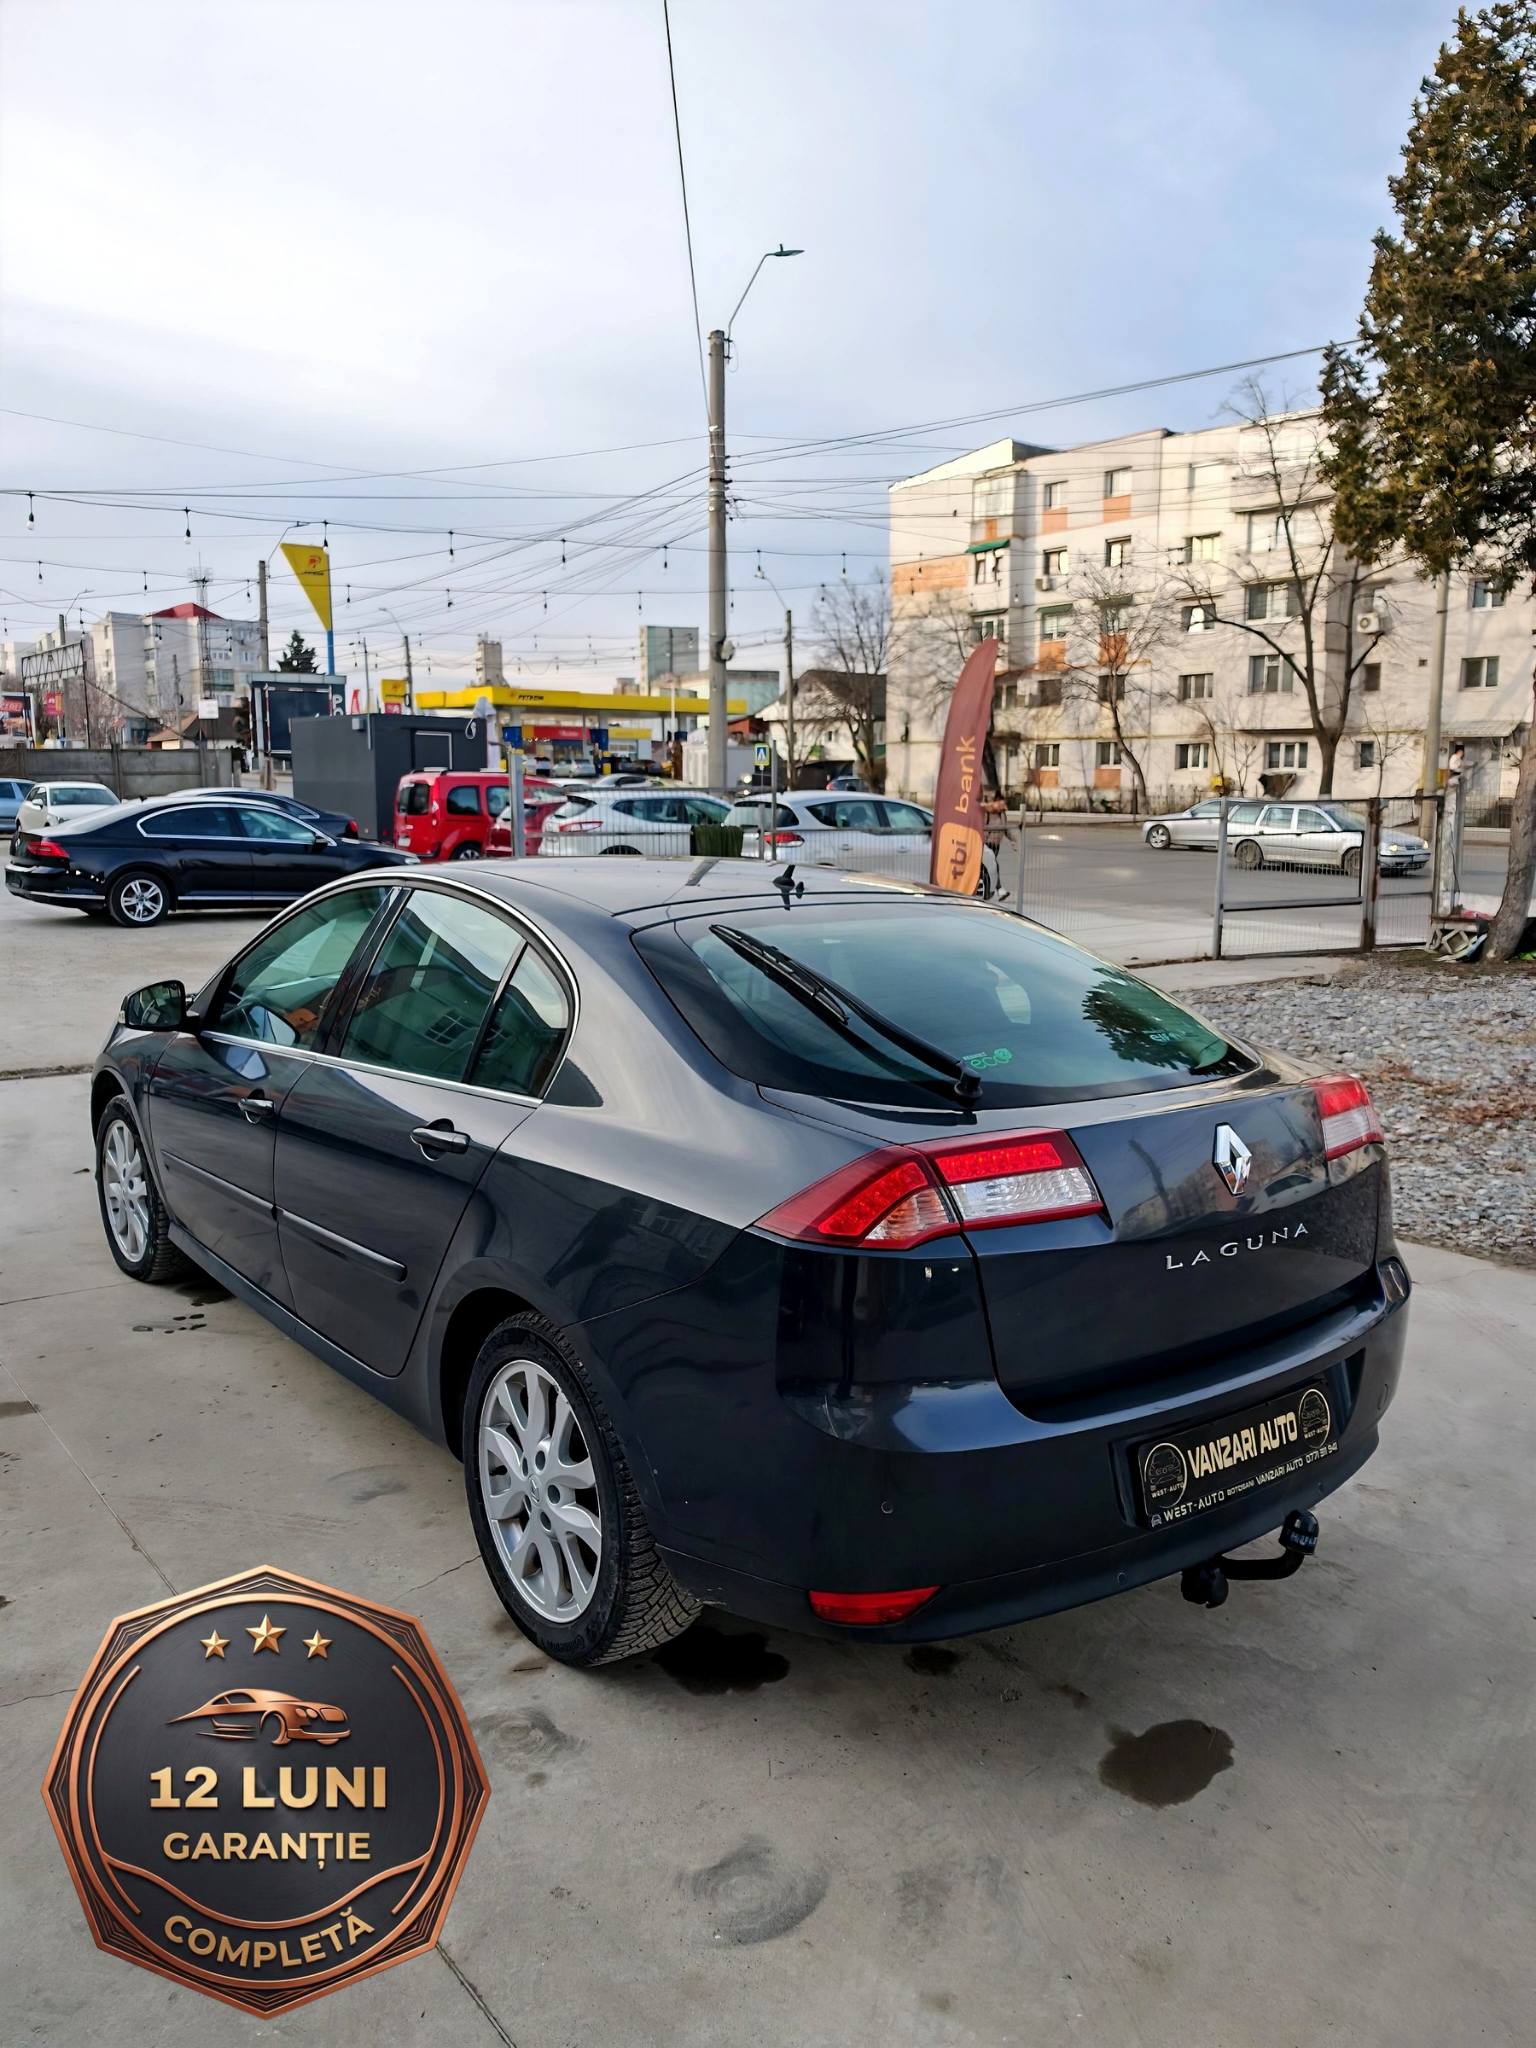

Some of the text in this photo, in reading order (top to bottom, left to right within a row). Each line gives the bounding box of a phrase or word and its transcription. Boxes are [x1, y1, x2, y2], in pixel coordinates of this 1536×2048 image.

[950, 736, 976, 879] tbi bank
[1166, 1223, 1308, 1270] LAGUNA
[1187, 1411, 1297, 1479] VANZARI AUTO
[1163, 1490, 1225, 1522] WEST-AUTO
[1255, 1465, 1285, 1485] VANZARI
[1286, 1457, 1304, 1473] AUTO
